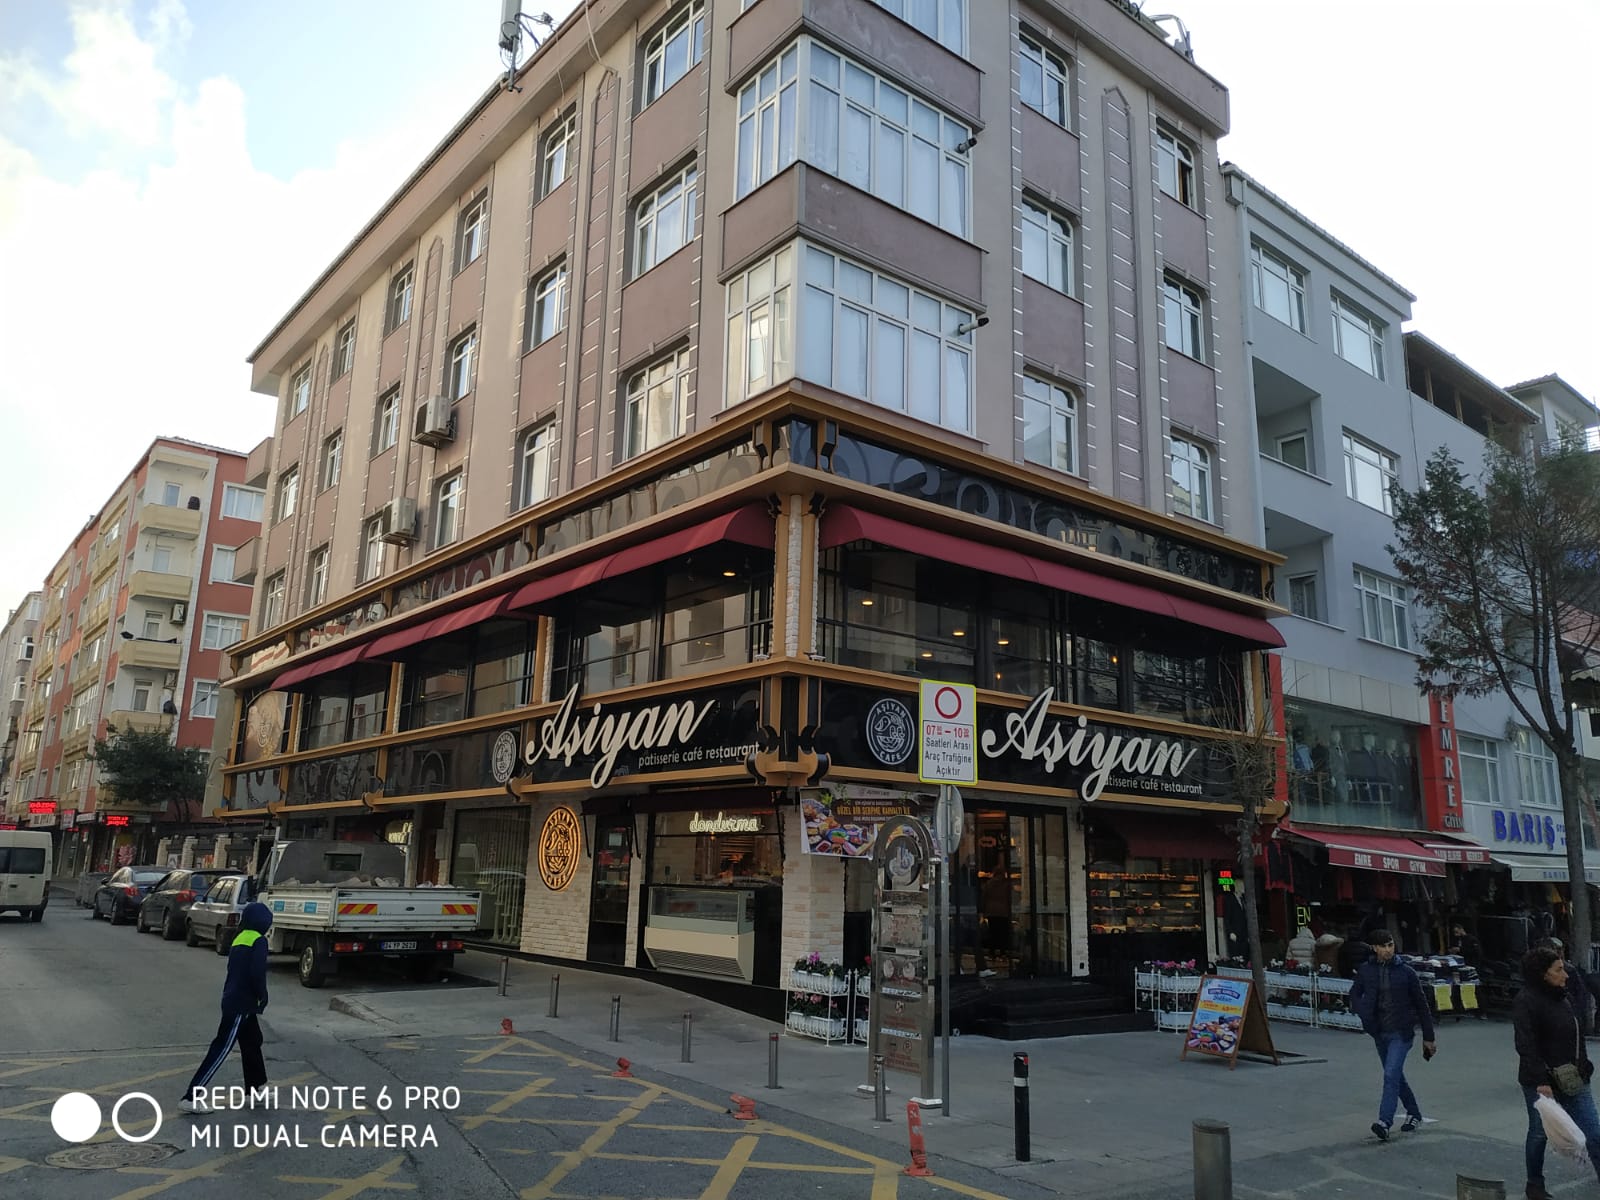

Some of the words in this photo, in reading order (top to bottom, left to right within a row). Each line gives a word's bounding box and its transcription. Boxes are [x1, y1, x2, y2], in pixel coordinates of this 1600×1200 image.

[525, 682, 716, 789] Aşiyan
[925, 737, 952, 749] Saatleri
[953, 740, 971, 751] Arası
[981, 686, 1198, 802] Aşiyan
[638, 750, 680, 769] patisserie
[682, 746, 703, 762] café
[705, 741, 760, 760] restaurant
[924, 750, 941, 763] Araç
[942, 751, 972, 766] Trafiğine
[1440, 700, 1457, 807] EMRE
[936, 765, 961, 777] Açıktır
[1105, 775, 1138, 789] tisserie
[1160, 781, 1203, 795] restaurant
[689, 811, 760, 833] dondurma
[1493, 810, 1556, 850] BARIŞ
[1354, 853, 1373, 867] EMRE
[1383, 857, 1400, 870] SPOR
